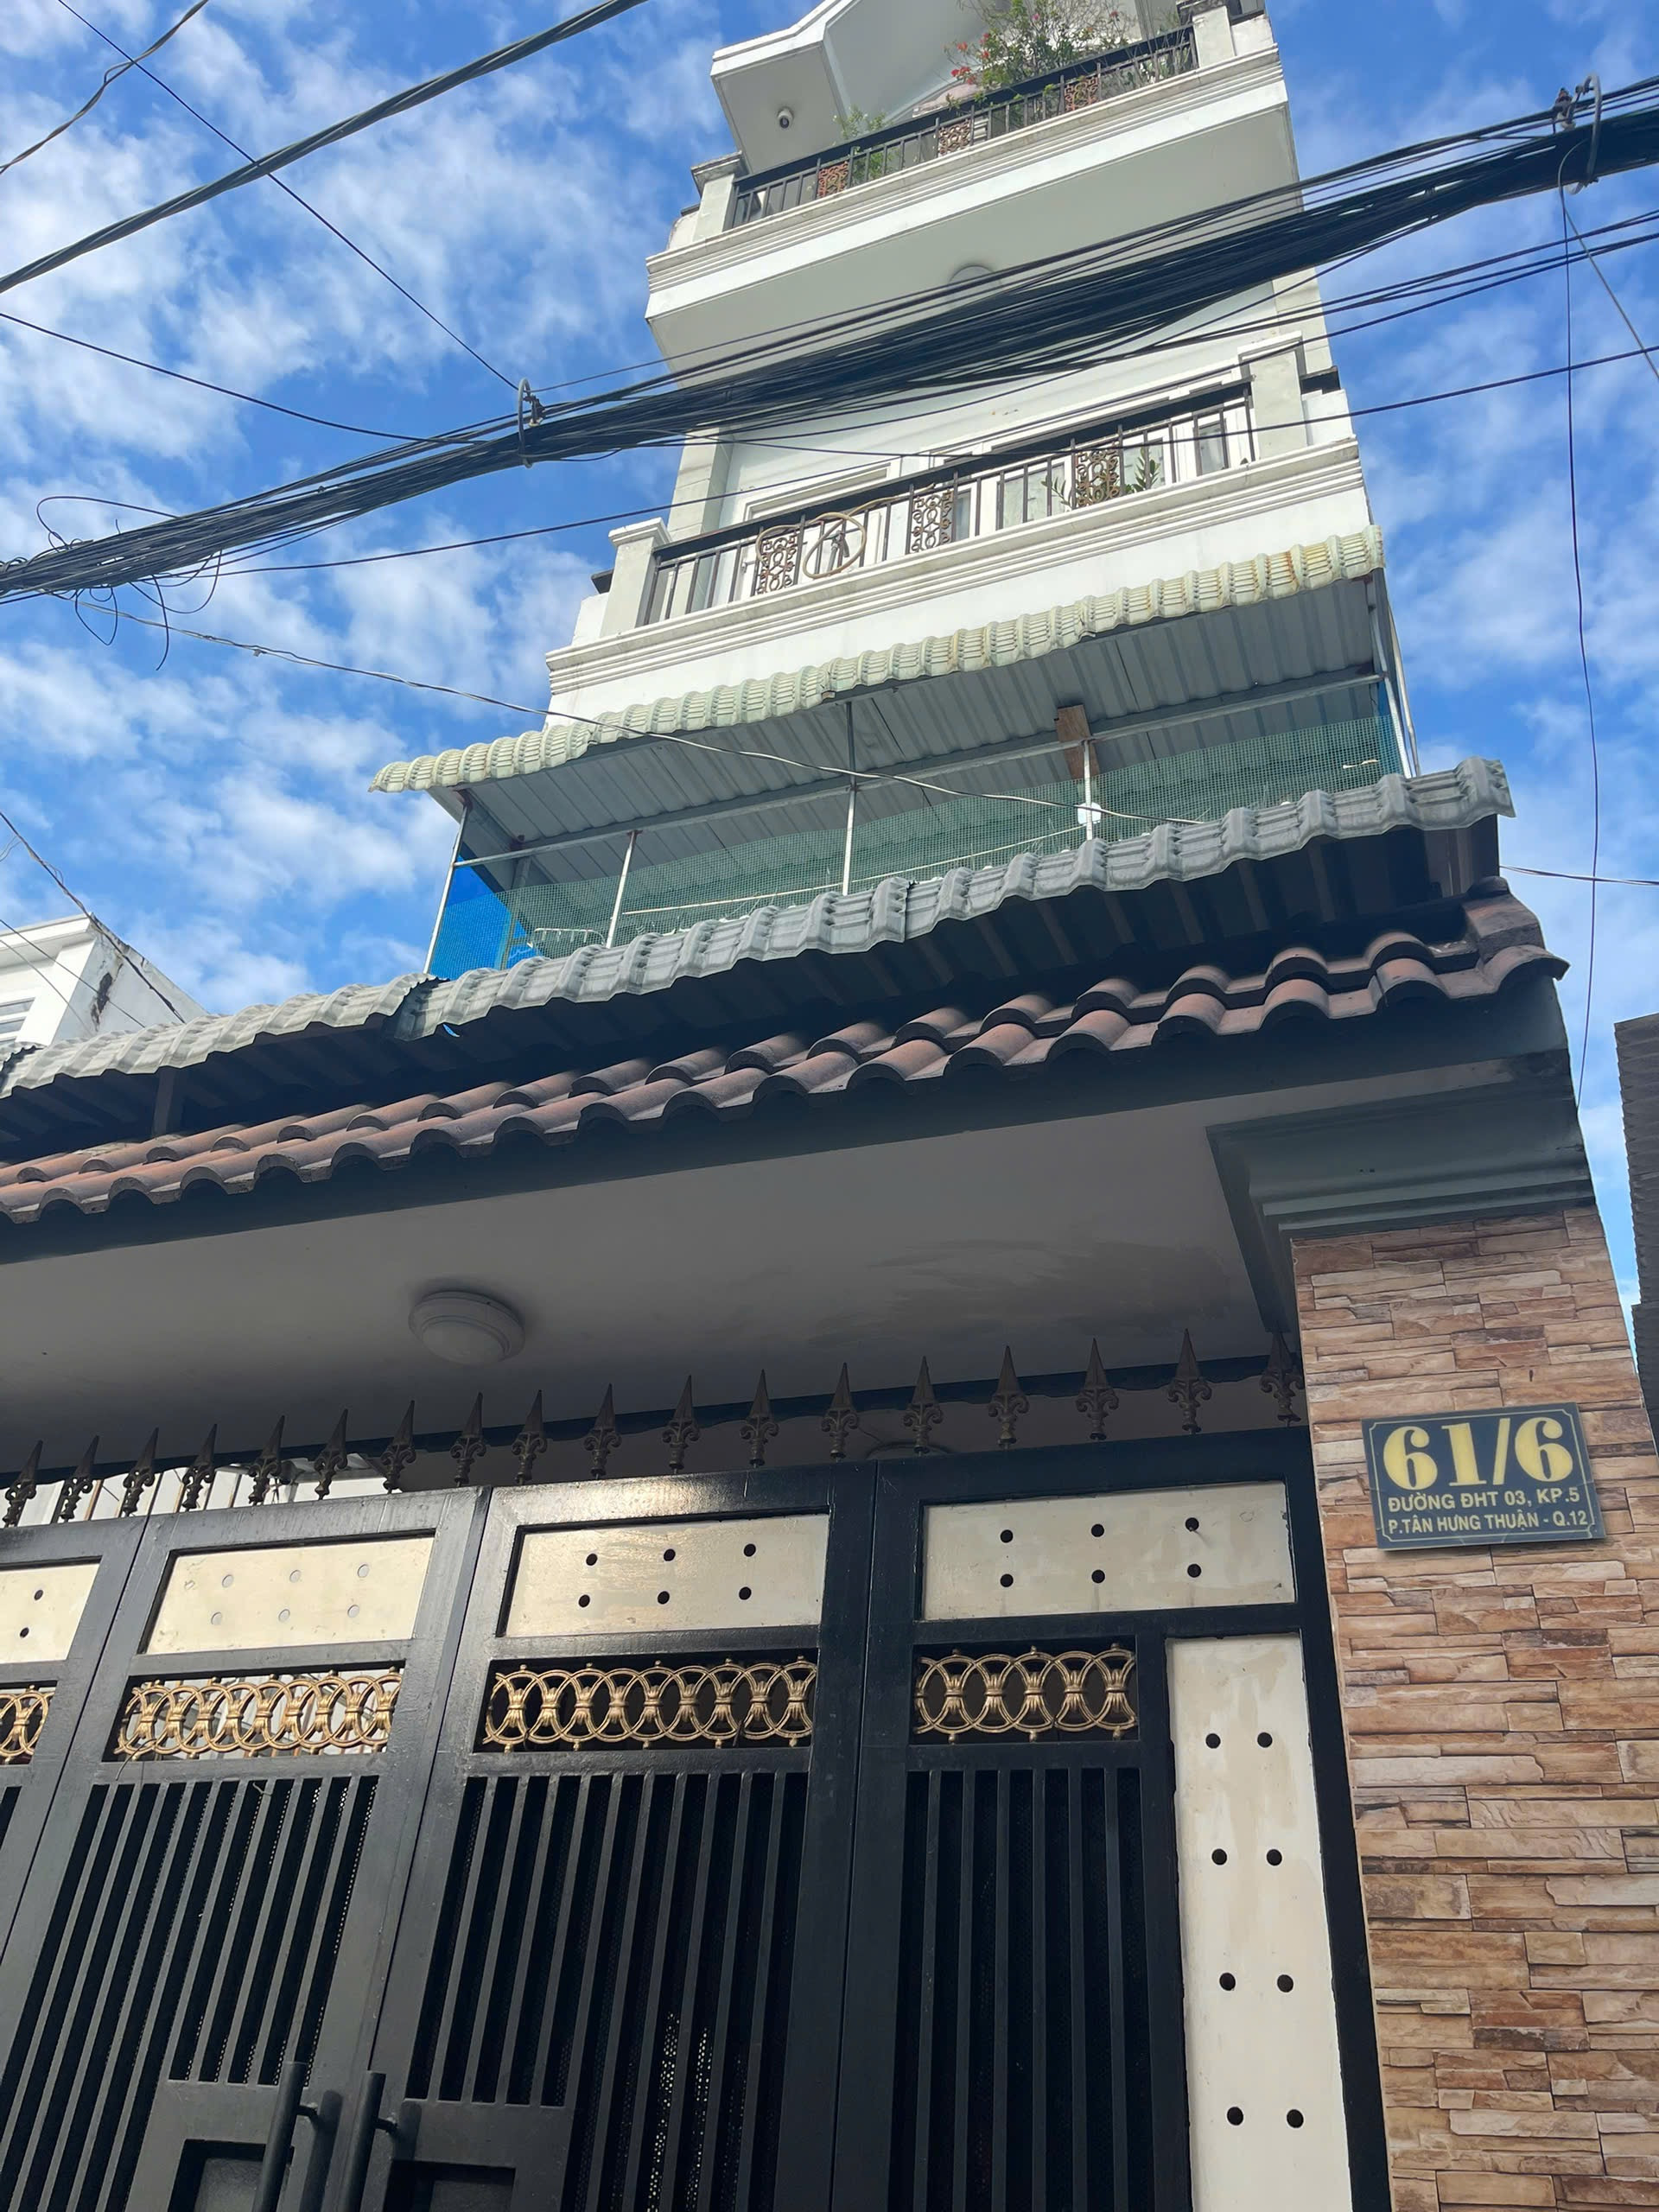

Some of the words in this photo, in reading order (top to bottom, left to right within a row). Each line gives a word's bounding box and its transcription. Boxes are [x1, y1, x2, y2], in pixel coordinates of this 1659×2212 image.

[1383, 1417, 1573, 1490] 61/6
[1388, 1491, 1456, 1512] ĐƯỜNG
[1461, 1491, 1498, 1509] ĐHT
[1505, 1490, 1532, 1506] 03,
[1389, 1514, 1433, 1534] P.TÂN
[1438, 1514, 1481, 1532] HƯNG
[1486, 1510, 1539, 1530] THUẬN
[1553, 1510, 1587, 1527] Q.12
